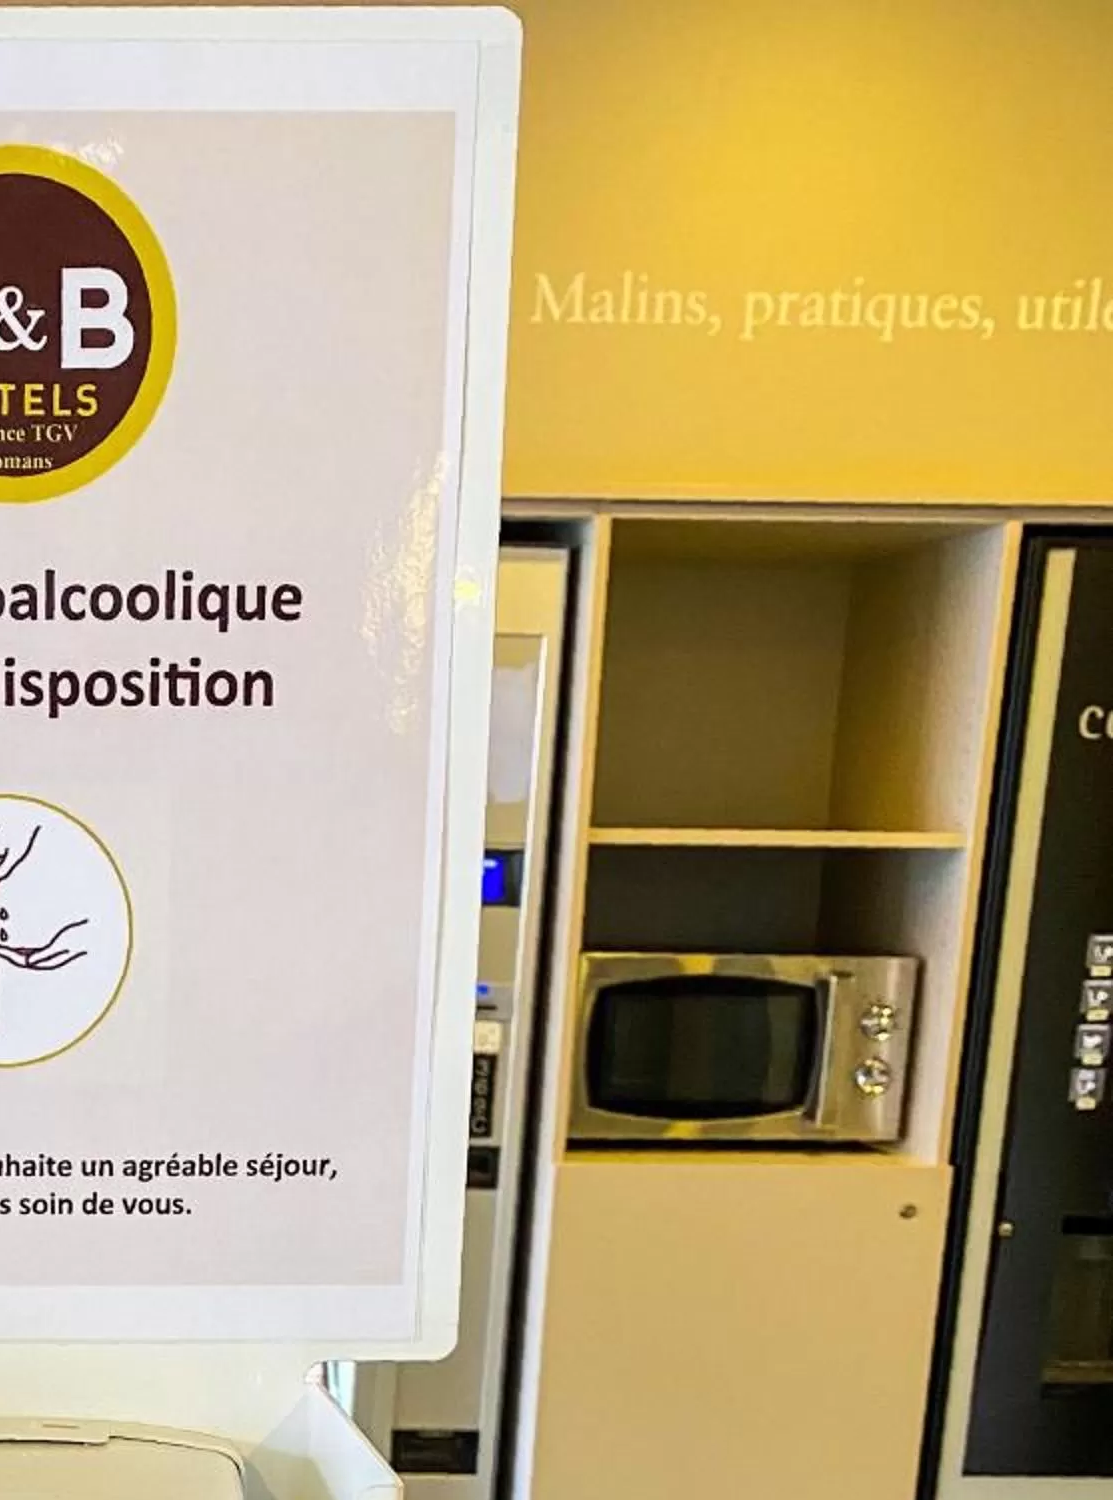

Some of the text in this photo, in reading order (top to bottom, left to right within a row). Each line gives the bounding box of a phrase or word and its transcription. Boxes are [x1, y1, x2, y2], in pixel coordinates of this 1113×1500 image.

[530, 270, 722, 336] Malins,
[739, 277, 996, 343] pratiques,
[31, 424, 77, 441] TGV
[82, 1160, 113, 1176] un
[123, 1153, 237, 1182] agréable
[247, 1154, 337, 1182] séjour,
[20, 1193, 73, 1214] soin
[83, 1192, 113, 1214] de
[123, 1198, 191, 1214] vous.
